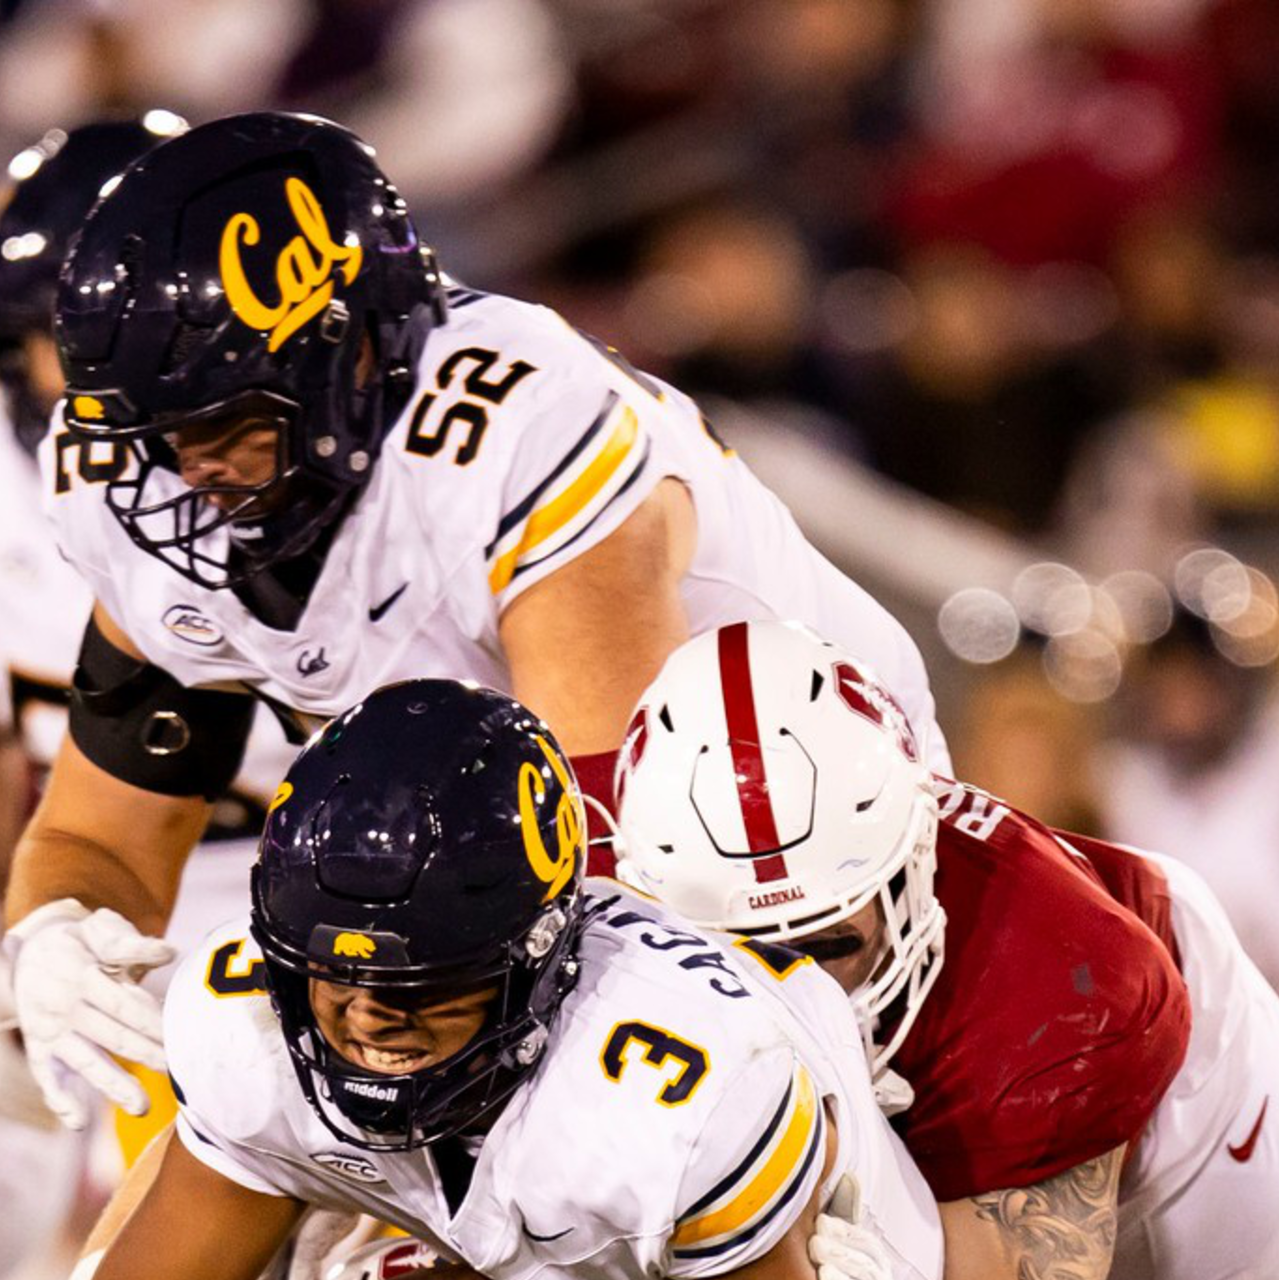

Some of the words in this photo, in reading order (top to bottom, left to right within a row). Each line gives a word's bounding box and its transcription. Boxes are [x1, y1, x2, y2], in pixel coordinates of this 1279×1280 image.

[220, 177, 363, 353] Cal
[404, 346, 539, 467] 52
[748, 885, 805, 910] CARDINAL
[599, 1018, 712, 1109] 3
